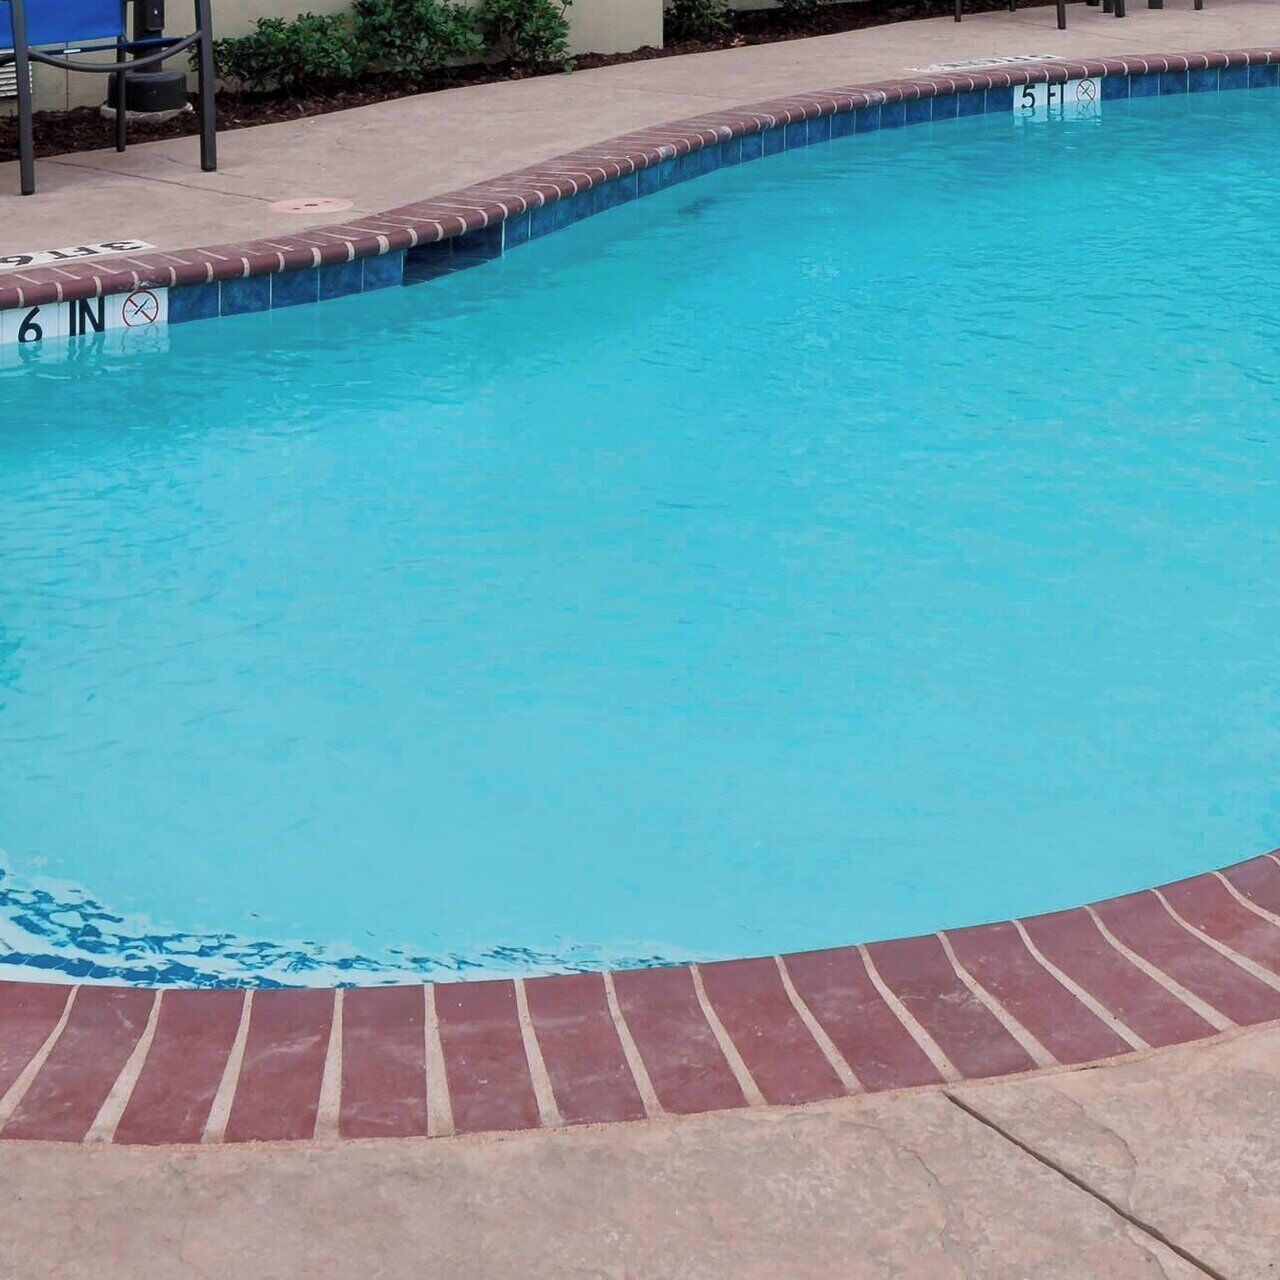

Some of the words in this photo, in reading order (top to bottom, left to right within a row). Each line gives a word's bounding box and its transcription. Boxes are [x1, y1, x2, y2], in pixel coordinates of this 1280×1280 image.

[1021, 85, 1035, 108] 5
[1047, 81, 1067, 106] FT
[100, 241, 142, 251] 3
[18, 305, 43, 343] 6
[69, 295, 105, 337] IN
